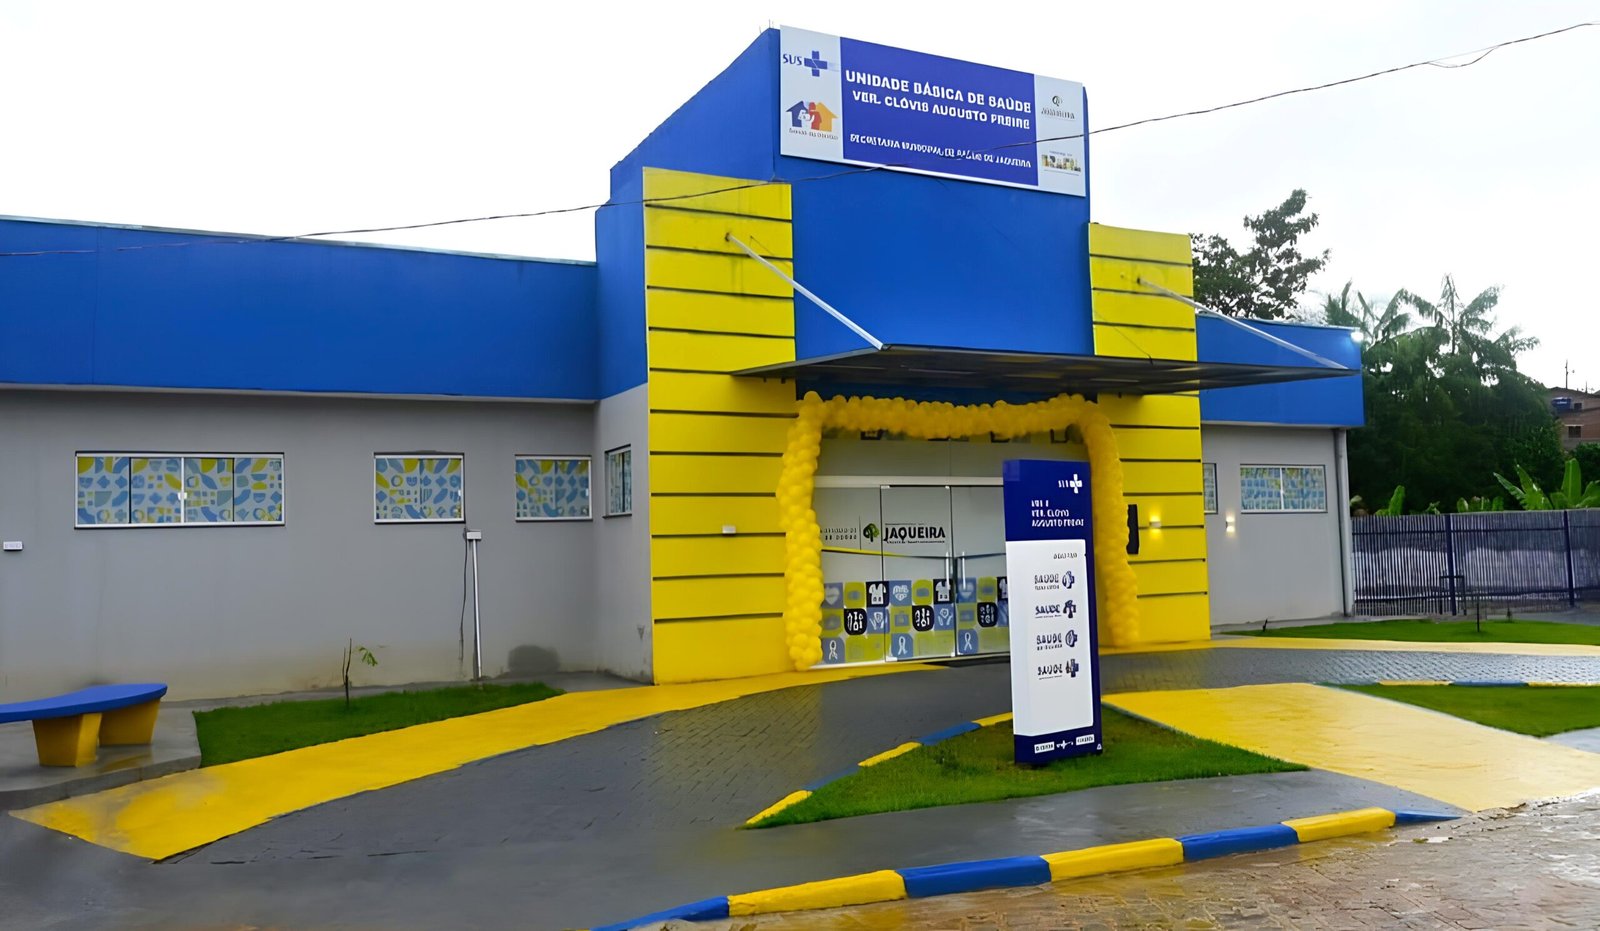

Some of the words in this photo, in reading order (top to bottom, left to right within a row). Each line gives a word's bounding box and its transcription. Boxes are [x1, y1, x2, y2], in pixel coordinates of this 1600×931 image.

[782, 53, 803, 66] SUS
[845, 69, 910, 92] UNIDADE
[913, 81, 964, 102] BÁSICA
[967, 91, 985, 106] DE
[988, 96, 1031, 114] SAÚDE
[884, 526, 947, 541] JAQUEIRA
